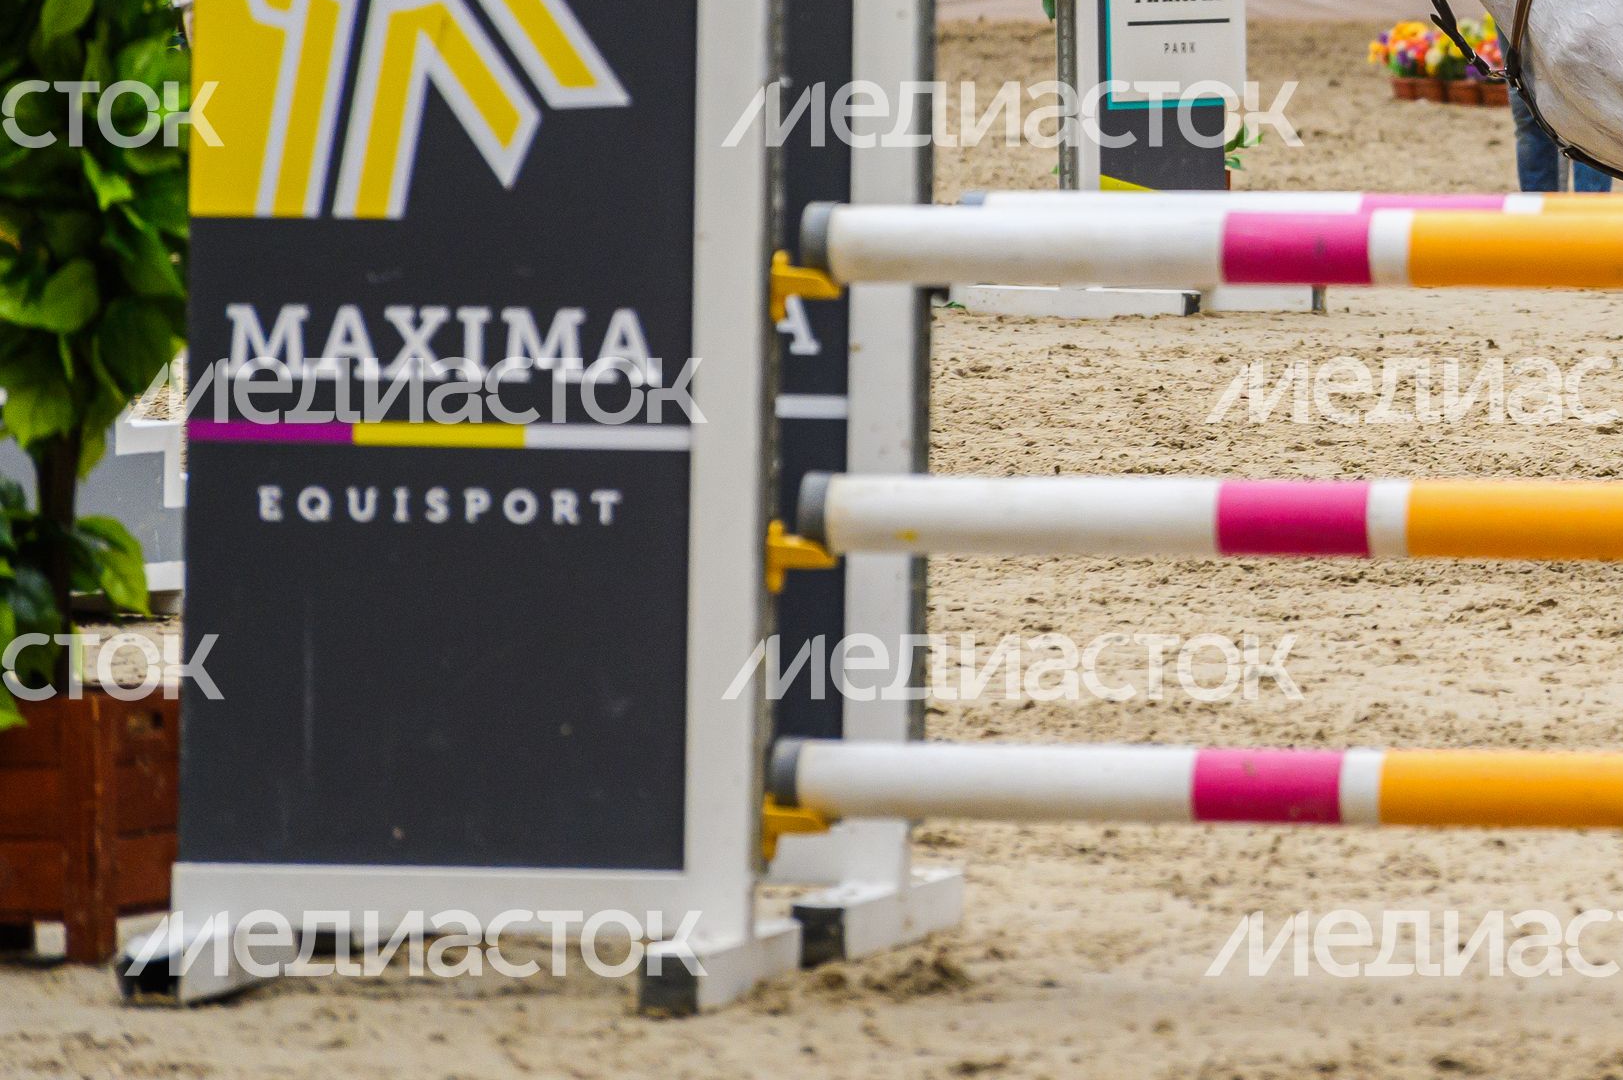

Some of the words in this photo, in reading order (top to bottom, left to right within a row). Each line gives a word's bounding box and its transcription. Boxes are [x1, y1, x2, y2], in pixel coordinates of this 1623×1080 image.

[1163, 41, 1196, 55] PARK
[222, 303, 662, 386] MAXIMA
[257, 484, 623, 525] EQUISPORT
